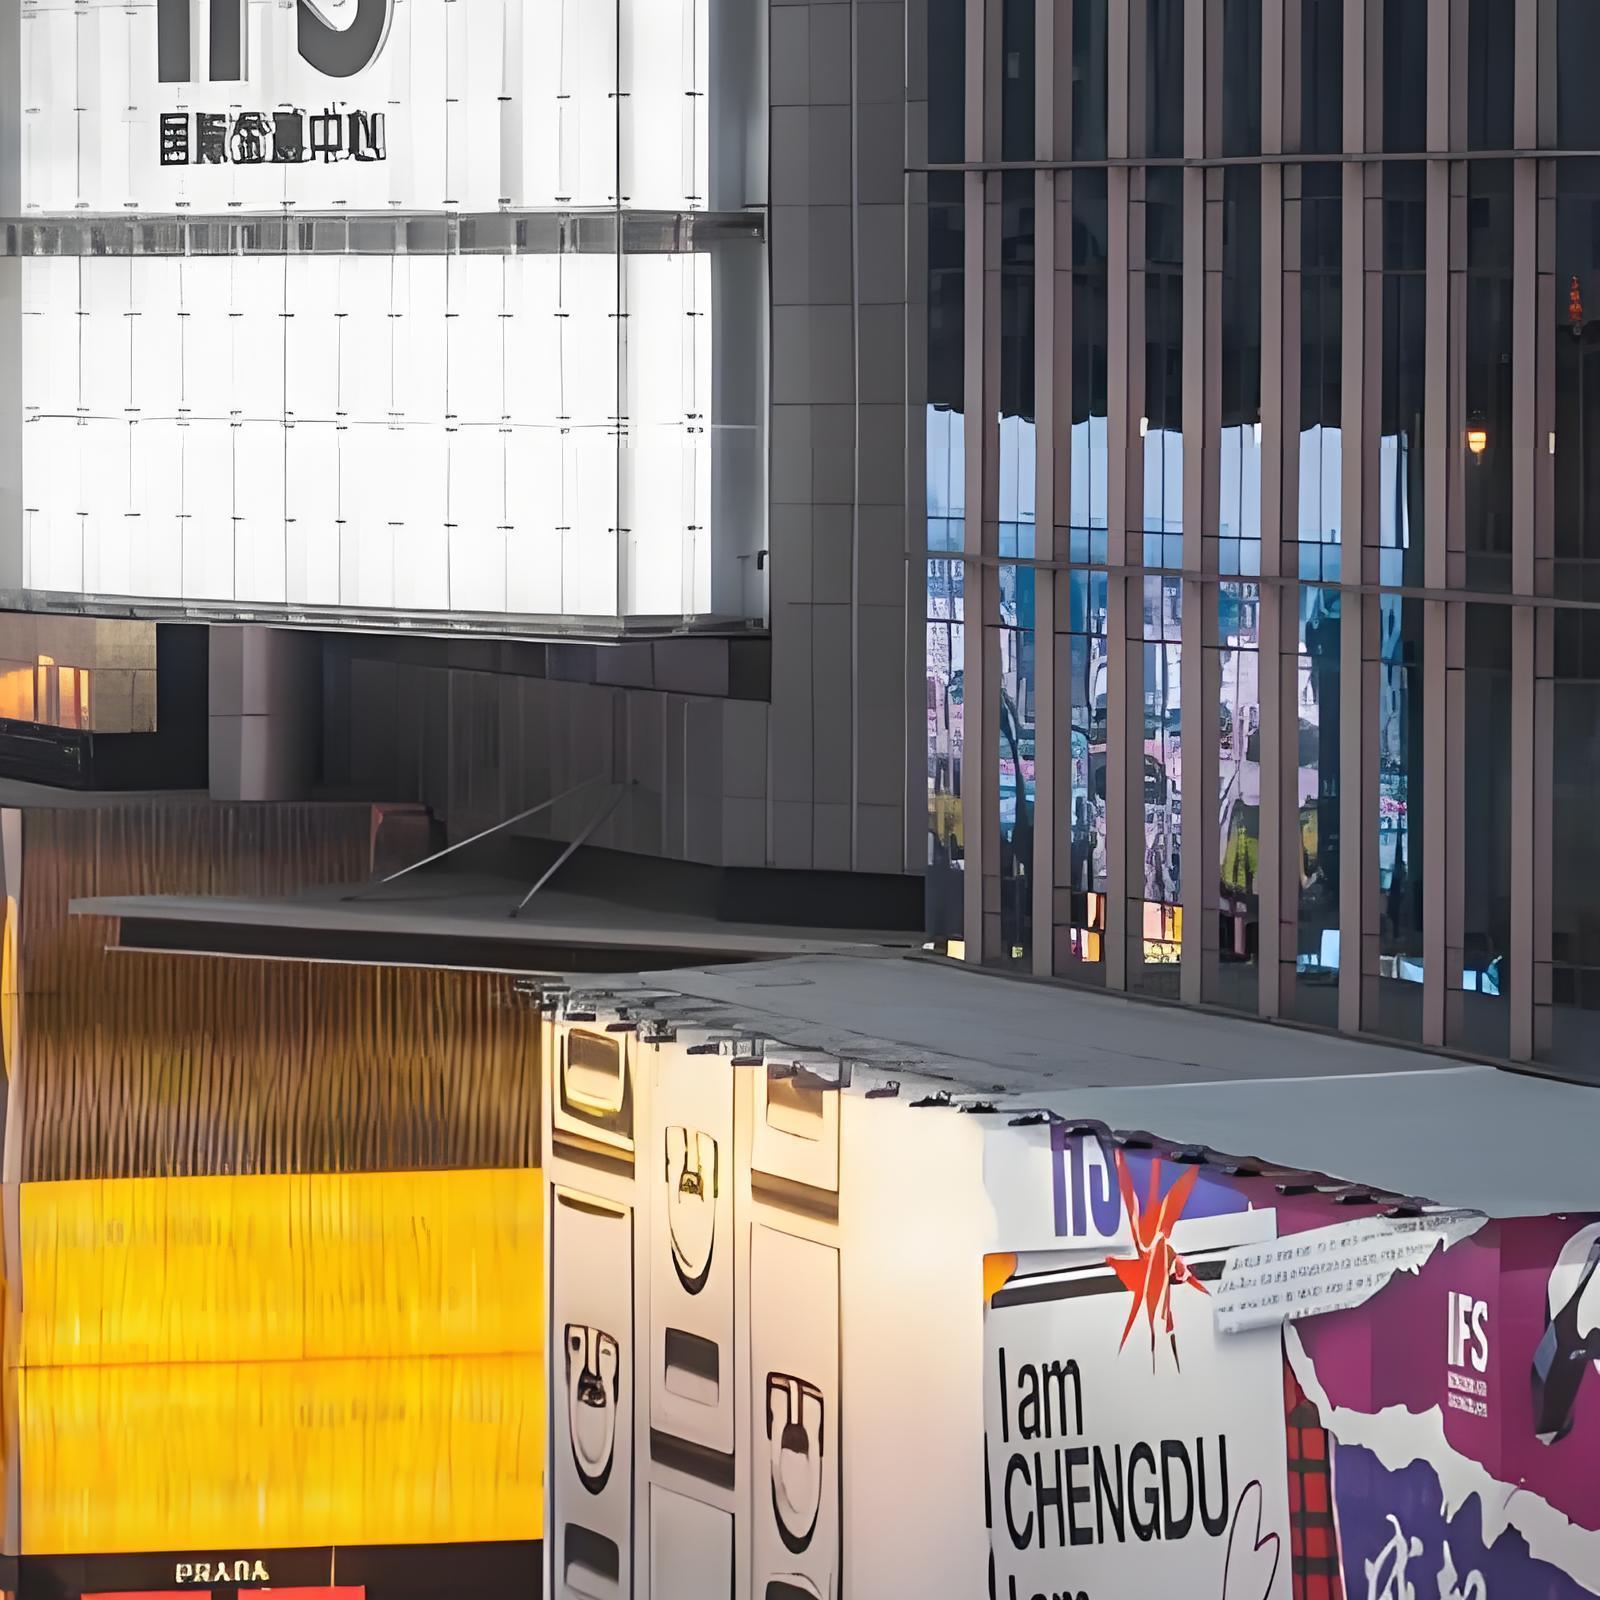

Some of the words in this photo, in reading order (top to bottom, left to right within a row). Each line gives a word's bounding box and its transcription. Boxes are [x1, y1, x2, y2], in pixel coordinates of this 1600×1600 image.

[1448, 1291, 1488, 1373] IFS
[998, 1347, 1009, 1443] I
[1018, 1359, 1083, 1440] am
[1004, 1434, 1229, 1550] CHENGDU
